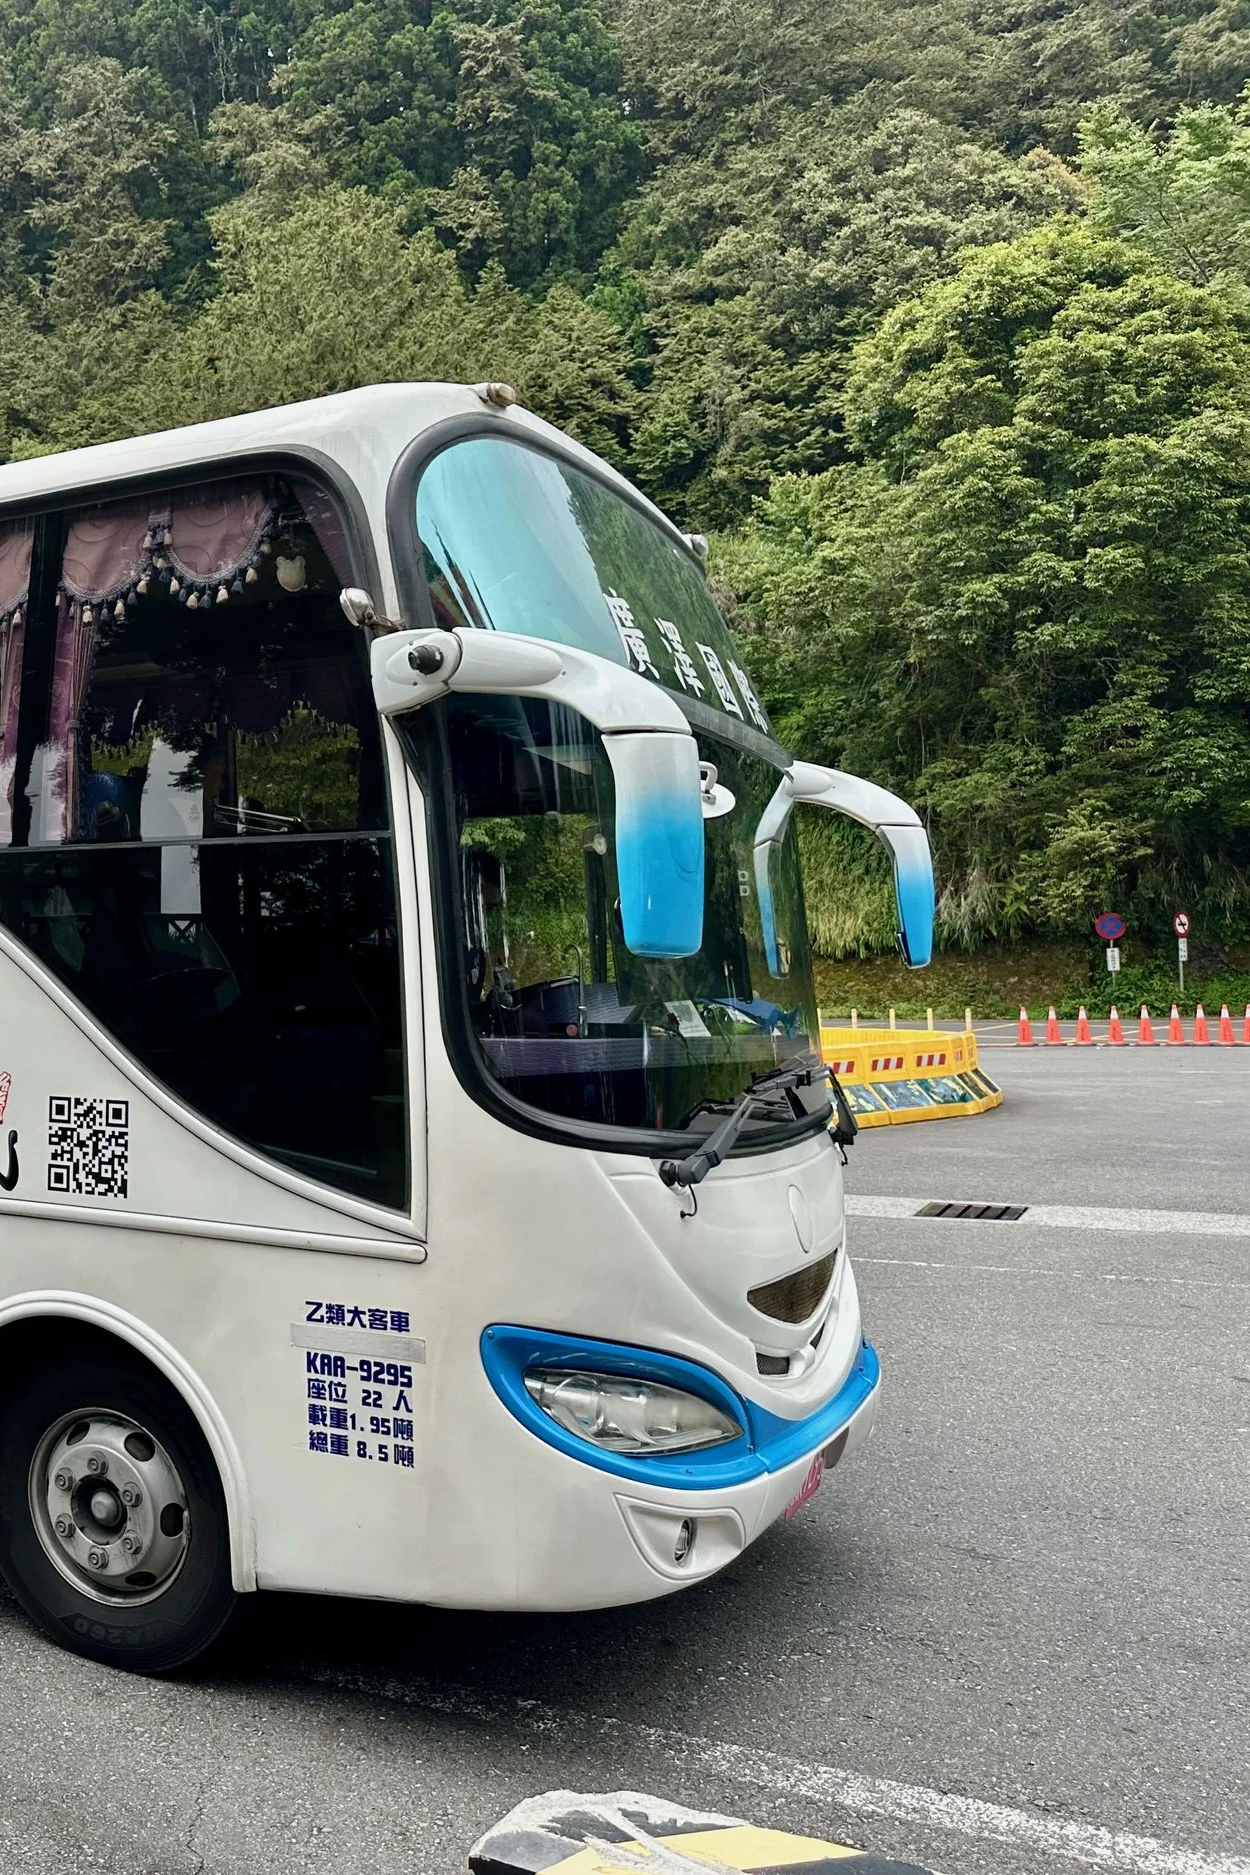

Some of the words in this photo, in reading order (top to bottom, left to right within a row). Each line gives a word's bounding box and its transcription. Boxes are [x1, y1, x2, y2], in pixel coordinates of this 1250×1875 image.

[305, 1301, 410, 1333] 乙類大客車
[306, 1351, 413, 1389] KAA-9295
[307, 1378, 348, 1404] 座位
[361, 1389, 383, 1409] 22
[392, 1389, 413, 1413] 人
